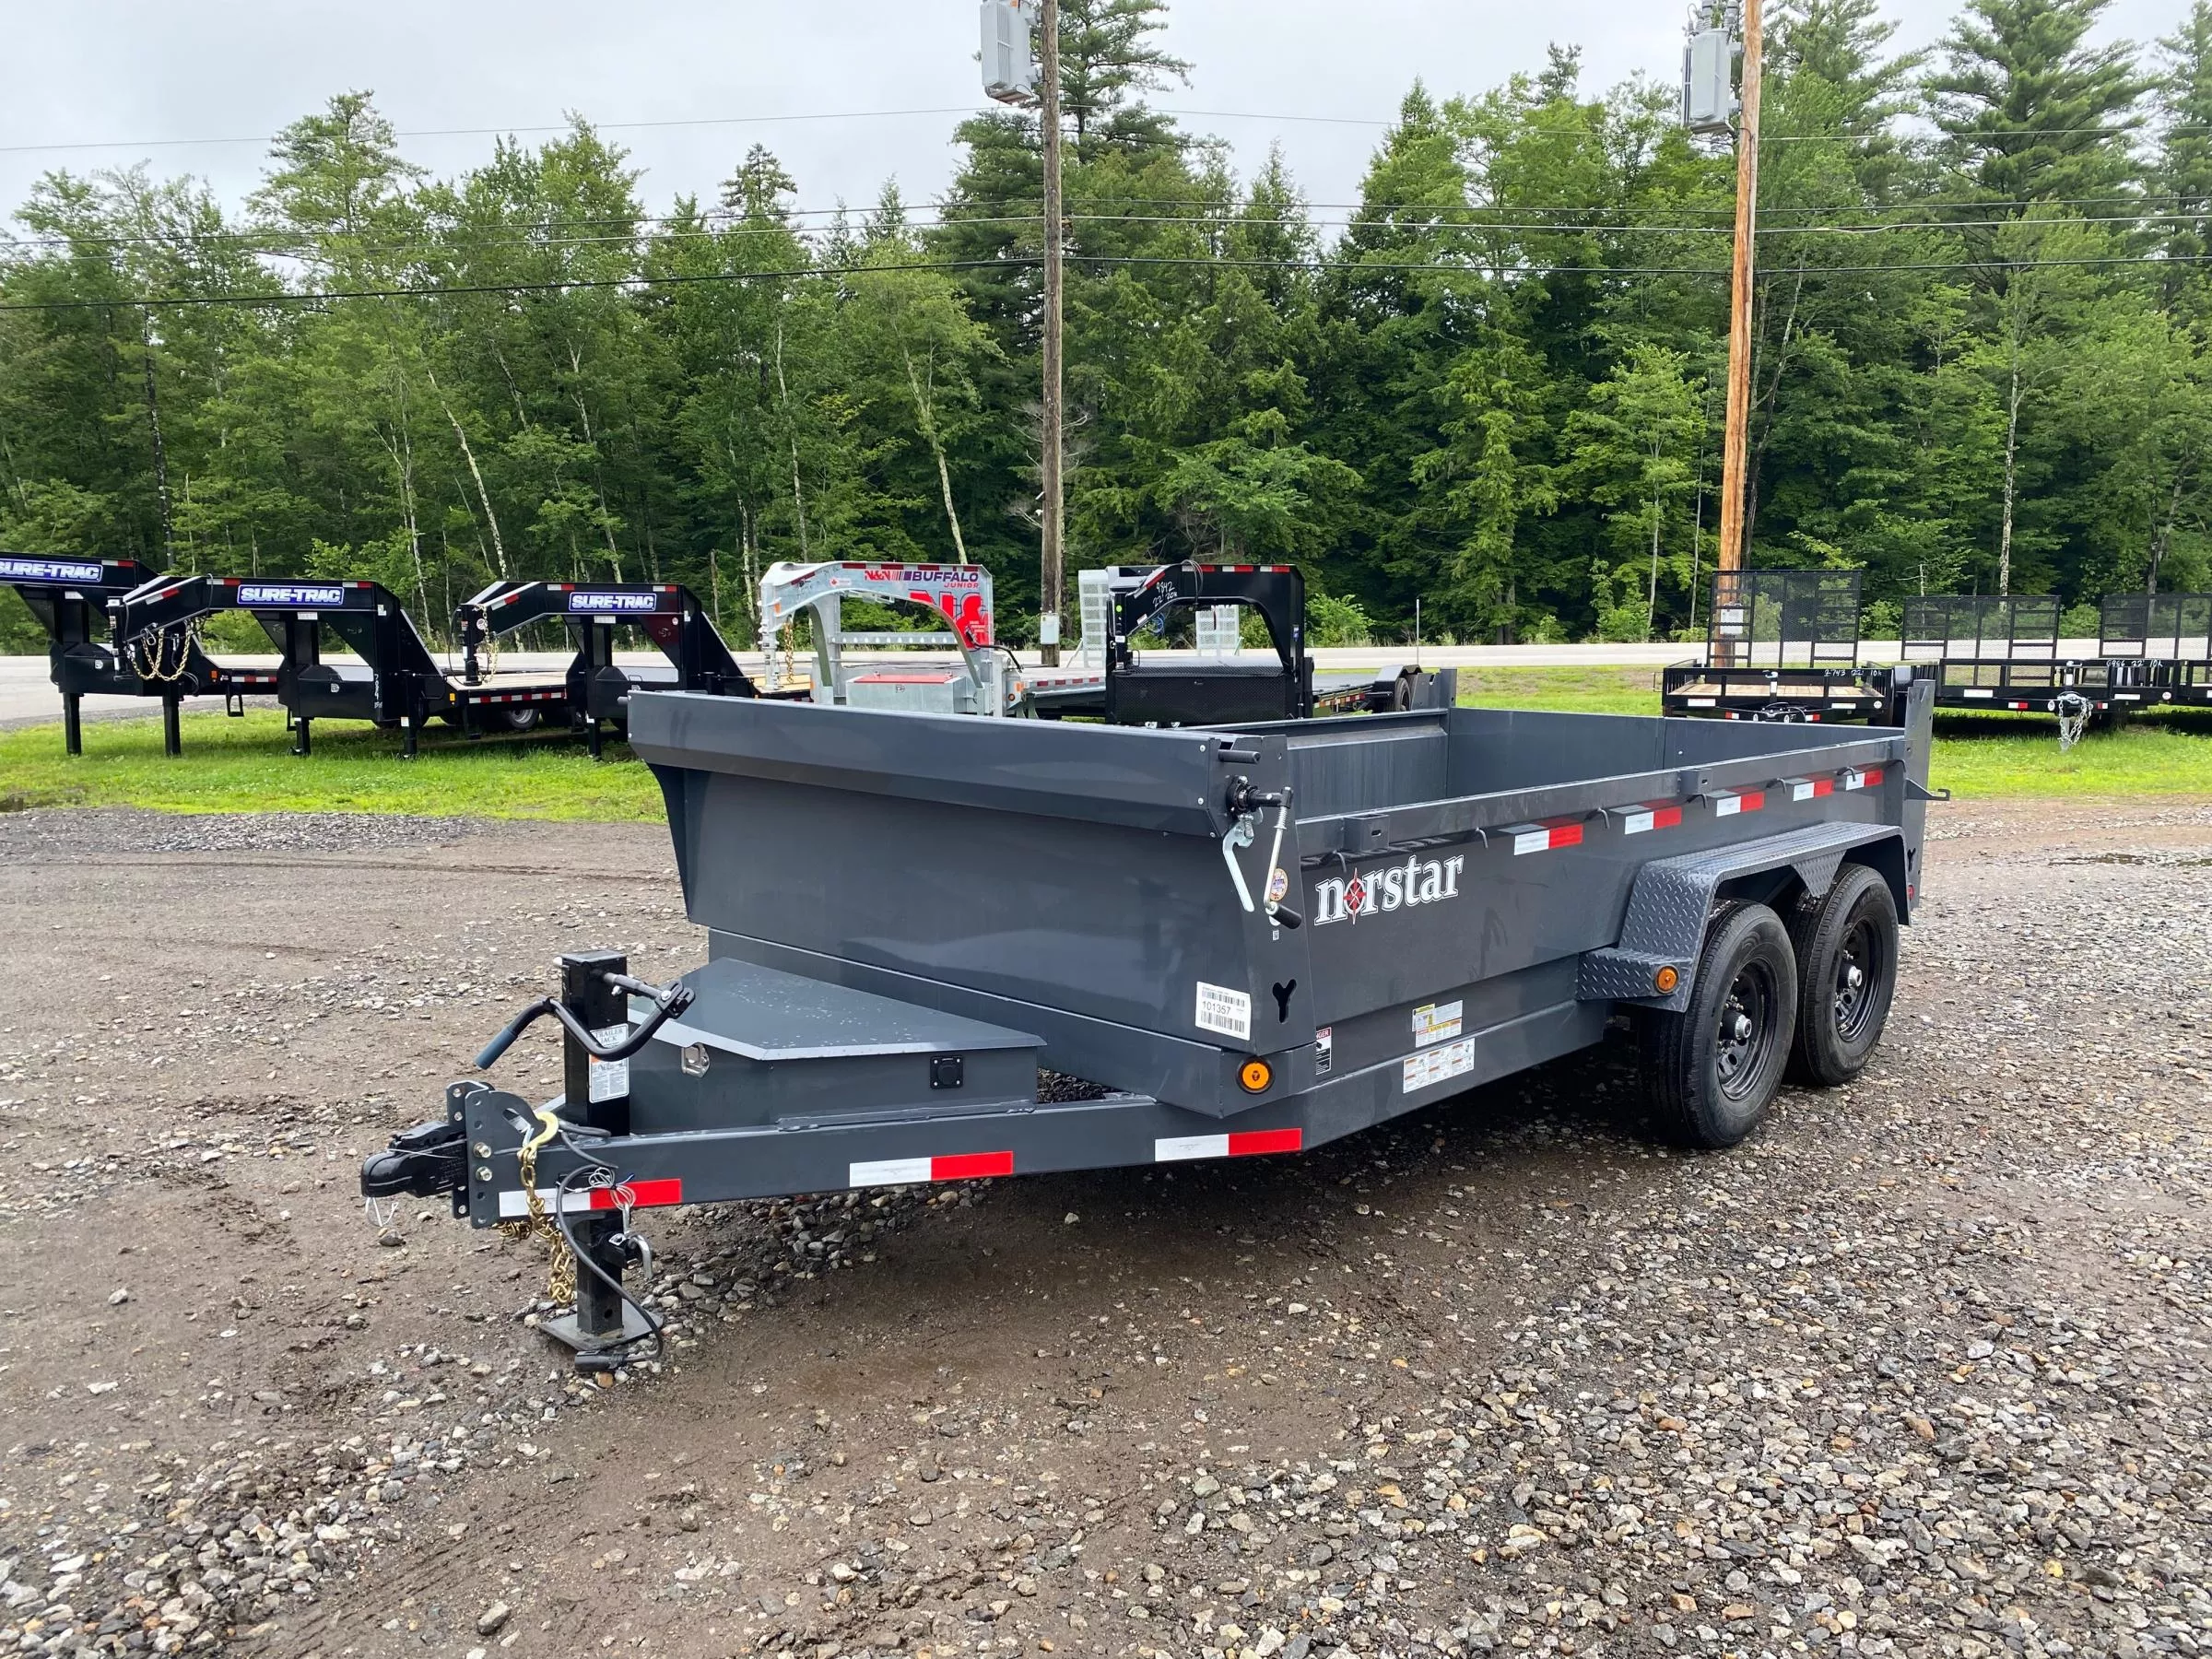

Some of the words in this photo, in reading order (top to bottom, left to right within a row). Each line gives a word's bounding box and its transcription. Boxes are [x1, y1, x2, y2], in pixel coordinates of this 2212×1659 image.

[912, 571, 979, 582] BUFFALO
[241, 587, 341, 605] SURE-TRAC
[571, 594, 654, 610] SURE-TRAC
[1313, 854, 1465, 925] norstar
[1202, 1000, 1231, 1016] 101357
